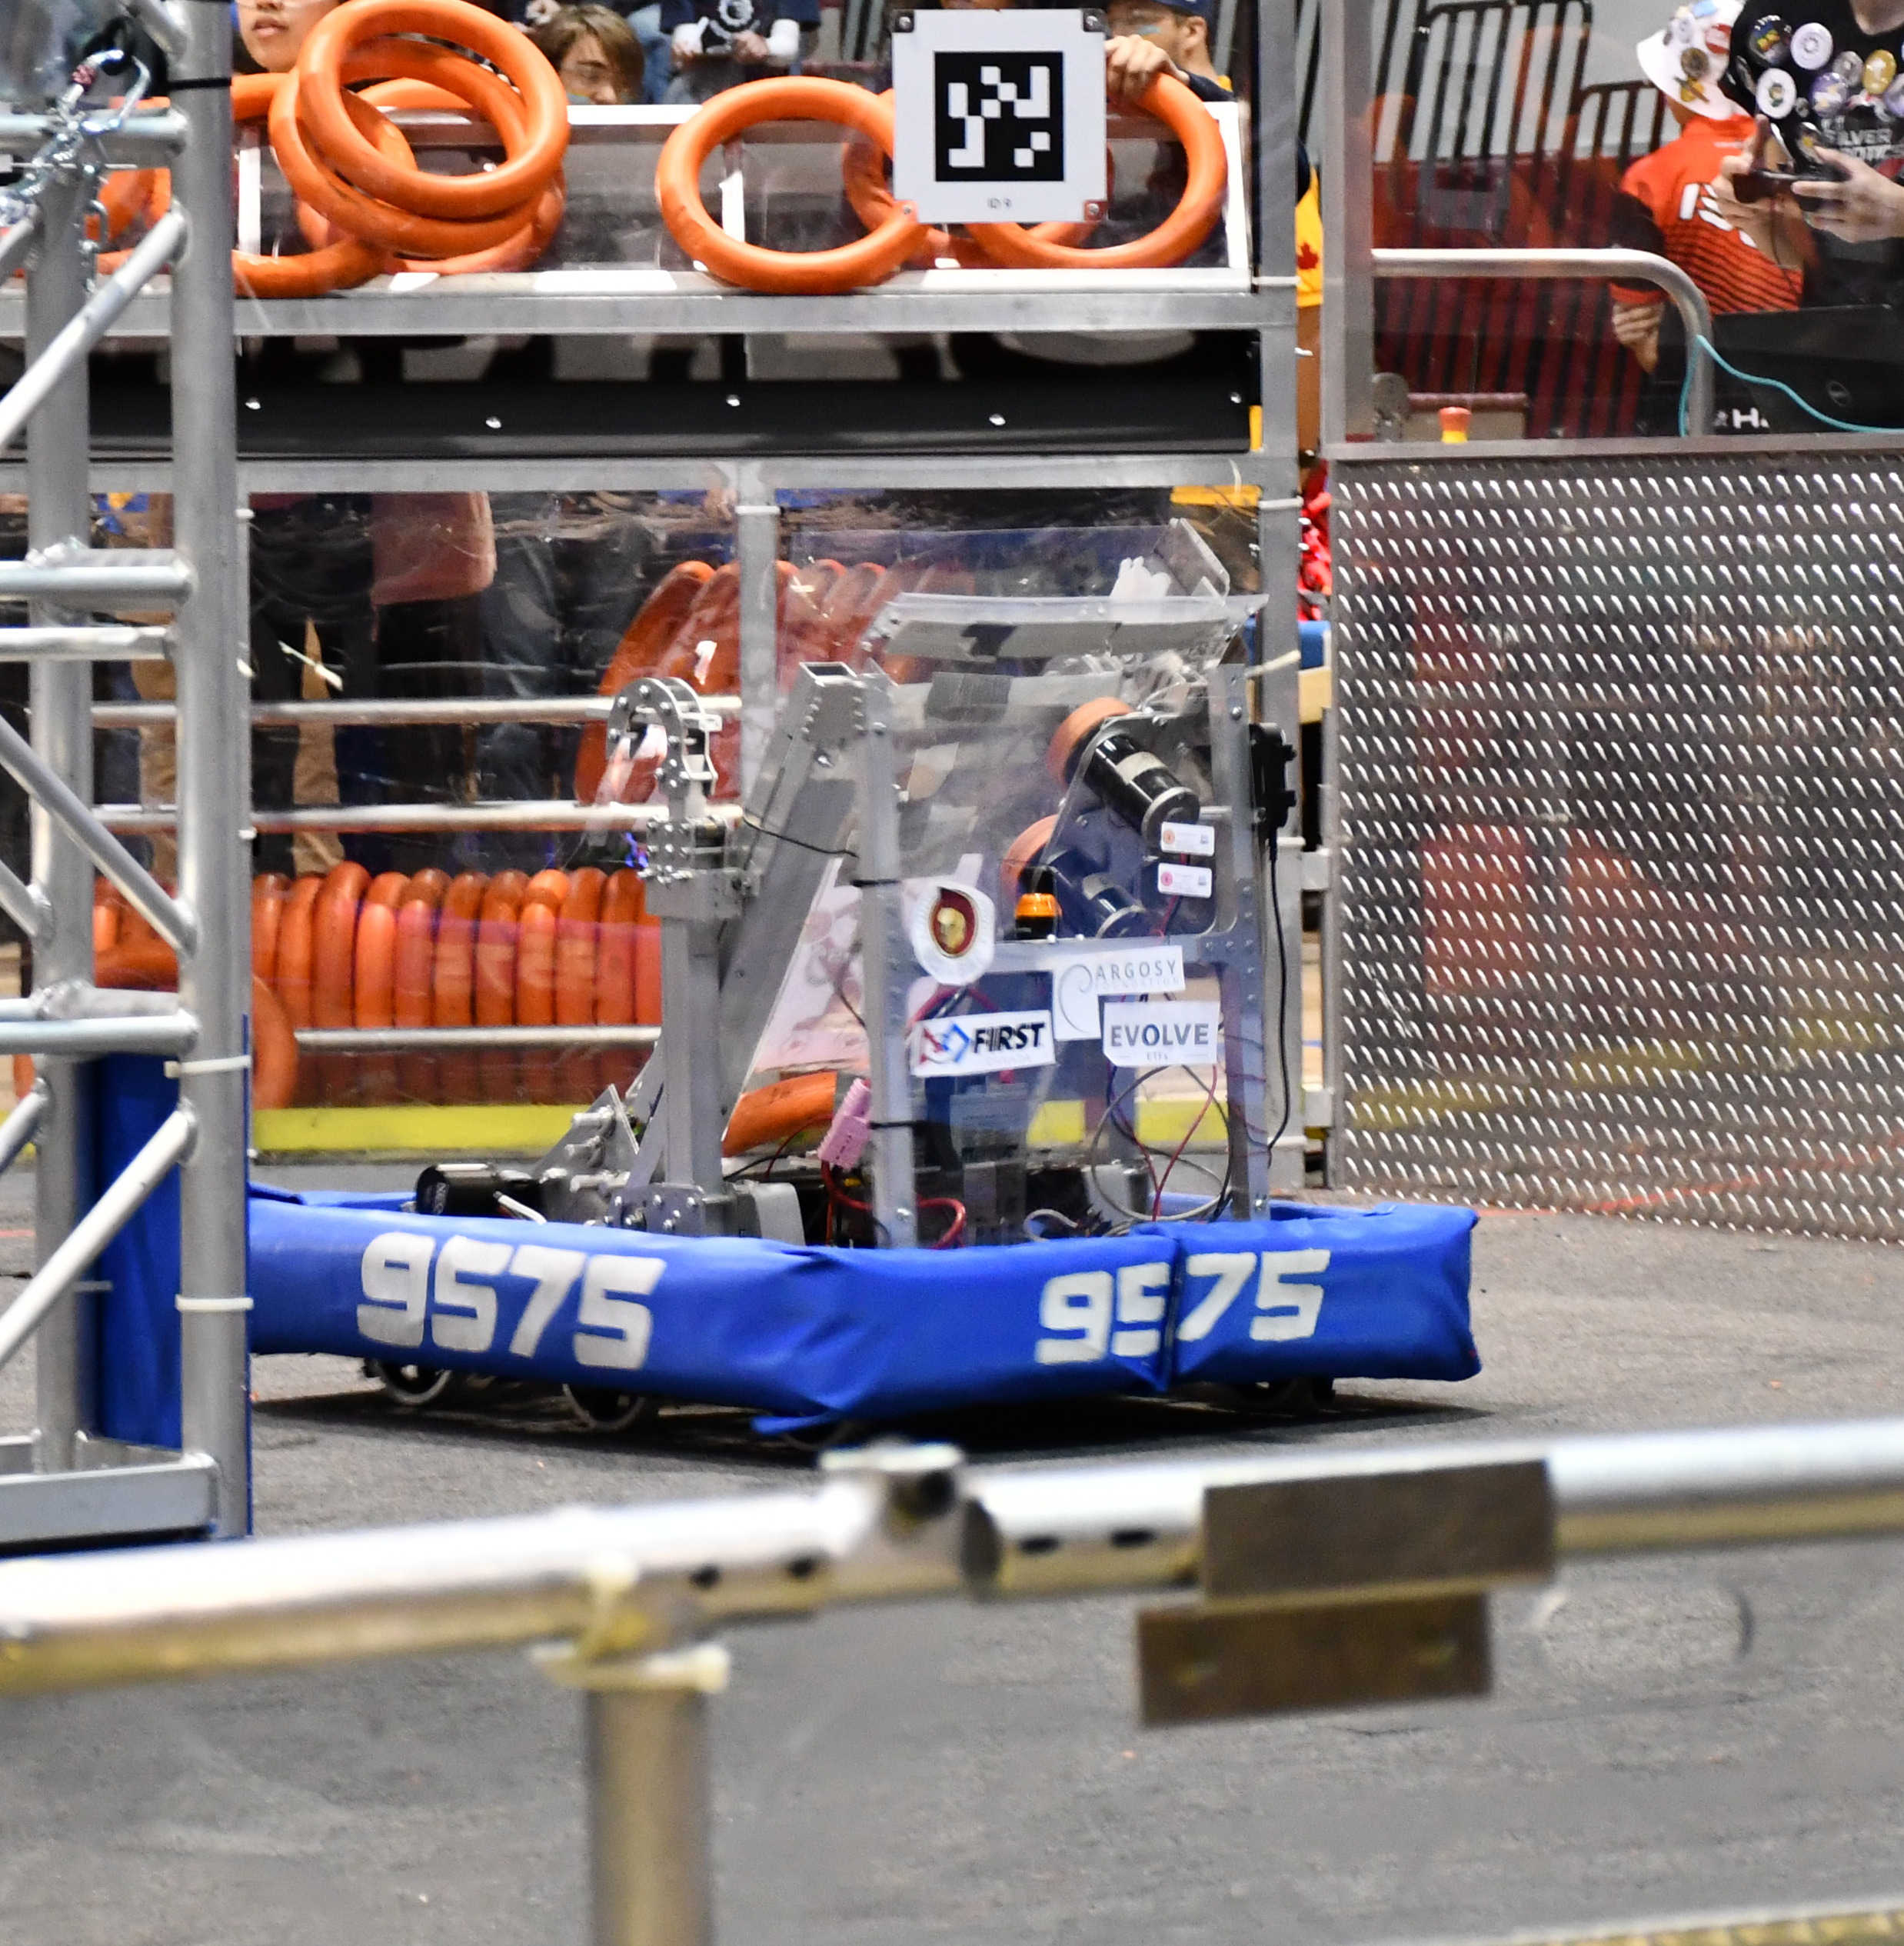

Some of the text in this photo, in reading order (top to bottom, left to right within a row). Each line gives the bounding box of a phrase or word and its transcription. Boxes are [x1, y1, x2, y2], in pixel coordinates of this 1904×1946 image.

[1095, 959, 1176, 981] ARGOSY
[974, 1022, 1044, 1053] FIRST
[1110, 1023, 1209, 1047] EVOLVE
[357, 1231, 667, 1370] 9575
[1034, 1248, 1331, 1365] 9575
